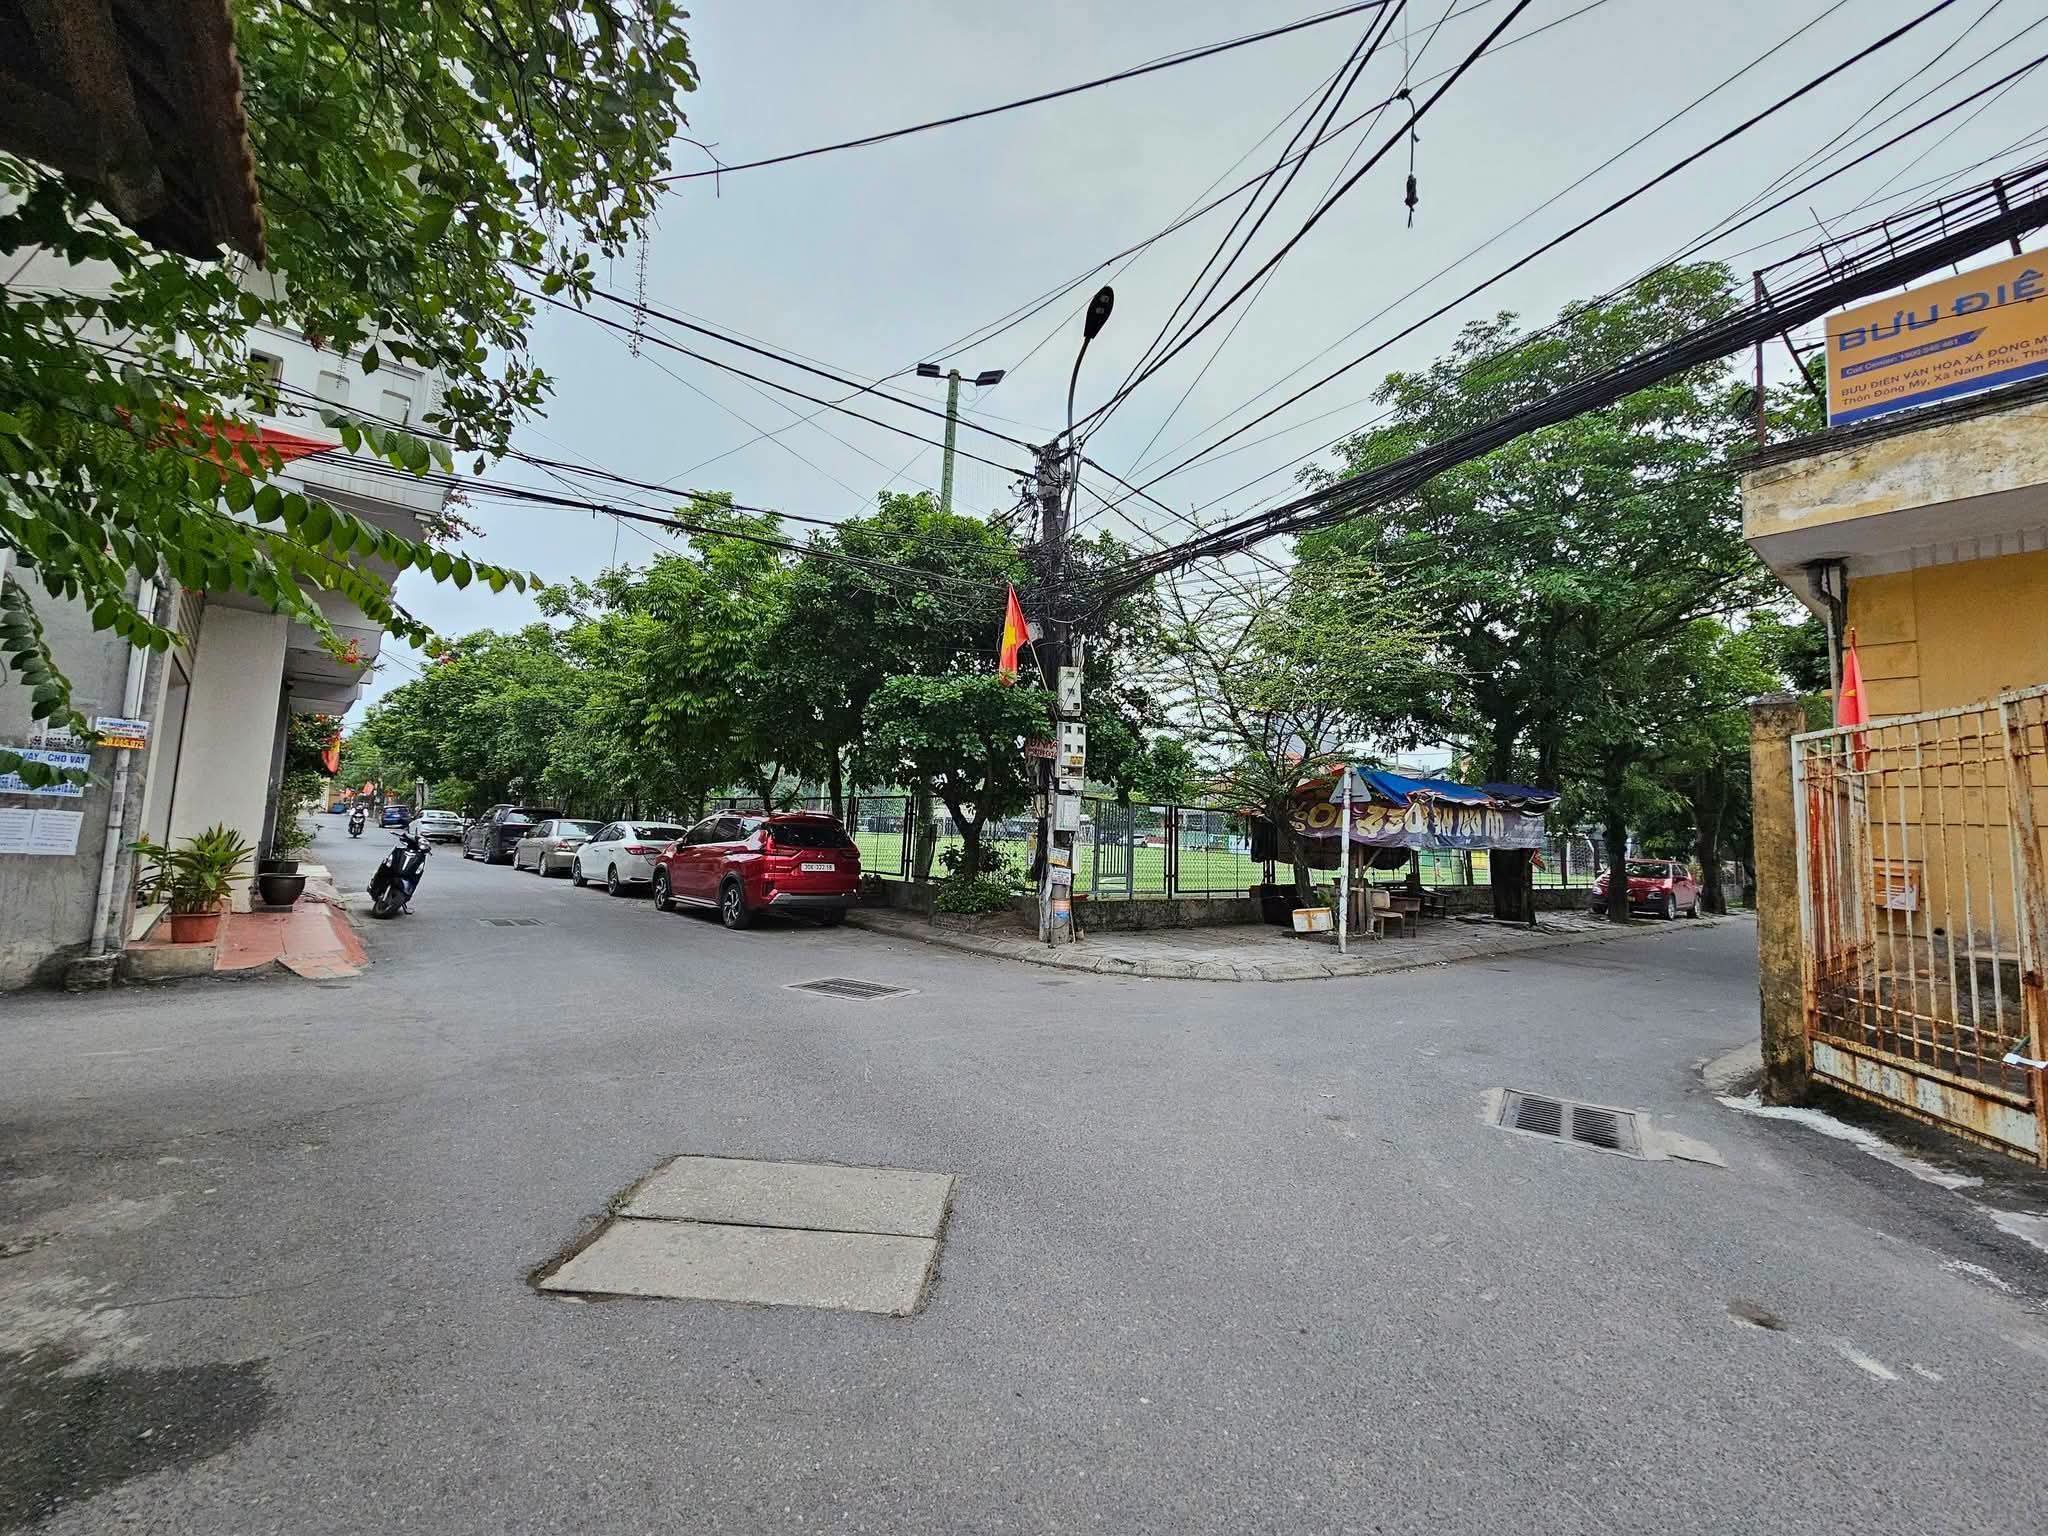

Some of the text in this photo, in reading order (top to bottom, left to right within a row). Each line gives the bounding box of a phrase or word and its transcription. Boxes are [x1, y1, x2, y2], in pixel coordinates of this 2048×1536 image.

[1840, 304, 1938, 352] BƯU
[47, 753, 87, 764] CHO VAY
